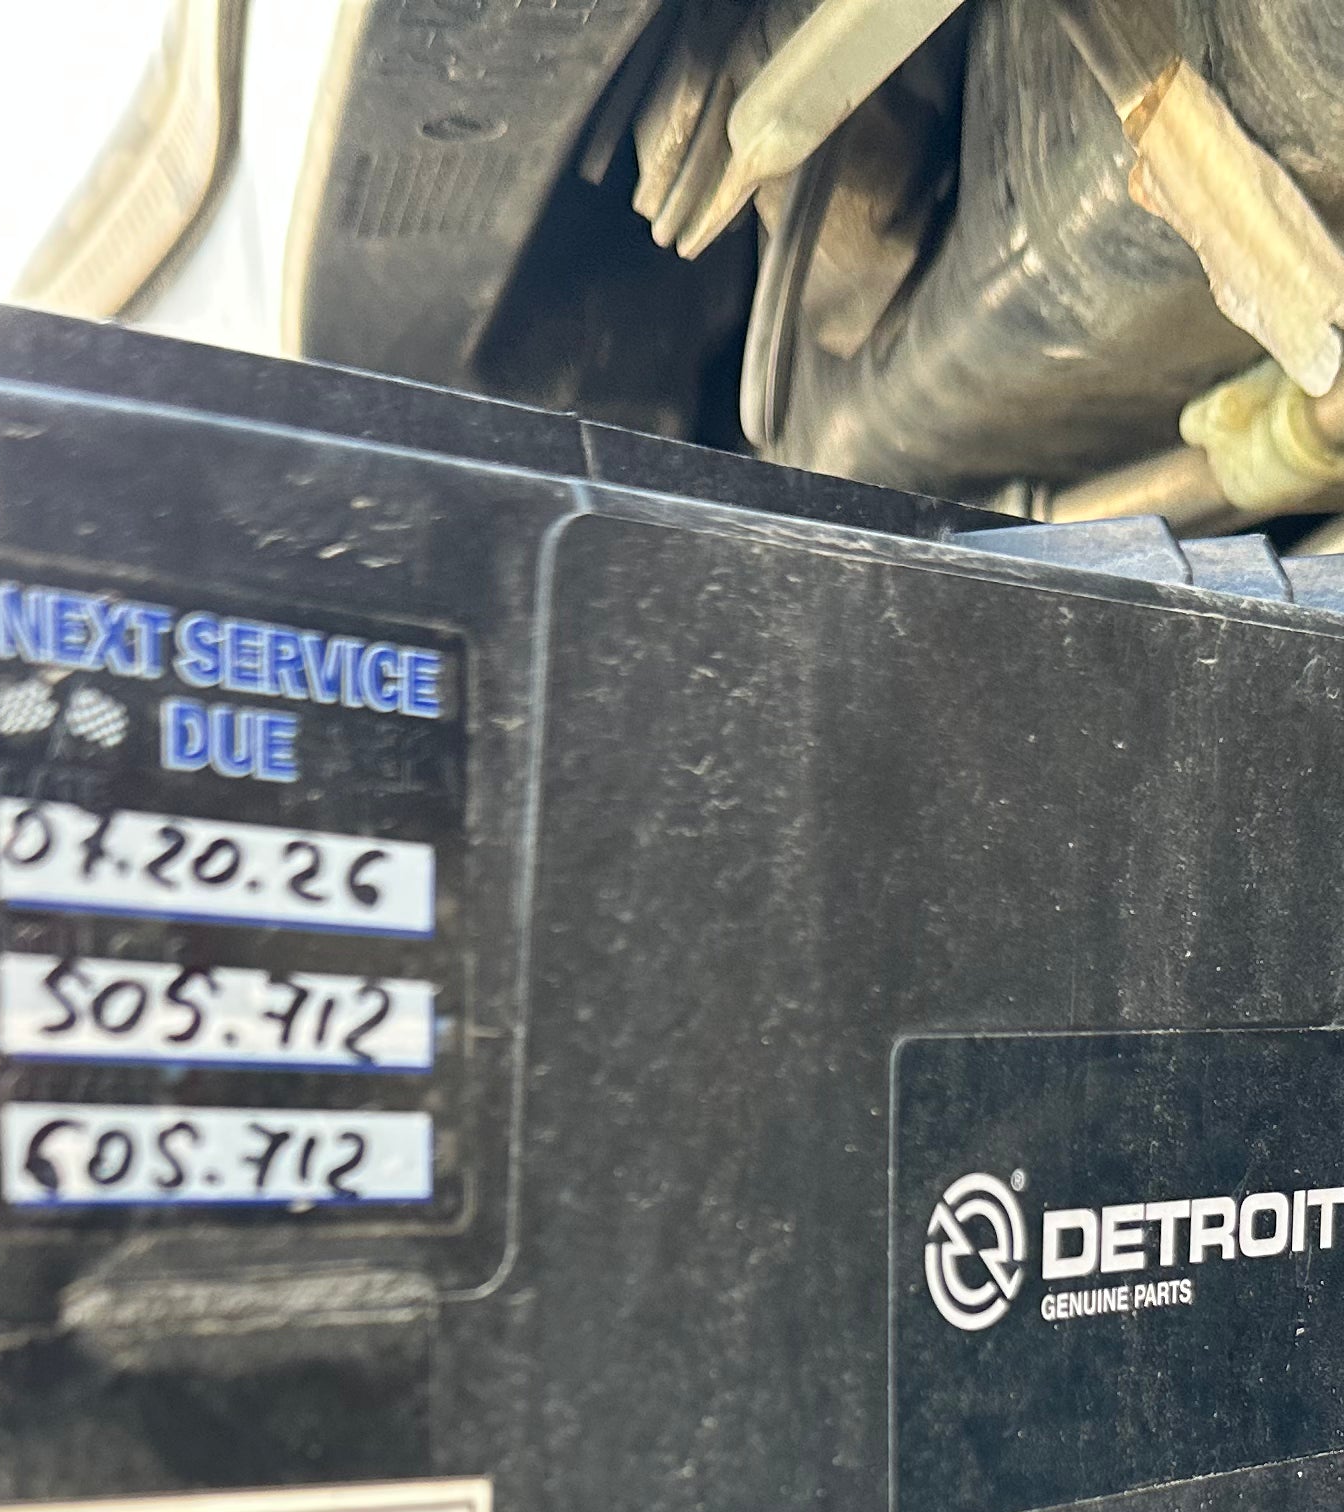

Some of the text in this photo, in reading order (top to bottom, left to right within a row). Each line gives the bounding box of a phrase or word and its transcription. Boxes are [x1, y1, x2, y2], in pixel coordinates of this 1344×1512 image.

[174, 610, 445, 719] SERVICE
[160, 695, 300, 783] DUE
[1041, 1278, 1193, 1322] GENUINE PARTS
